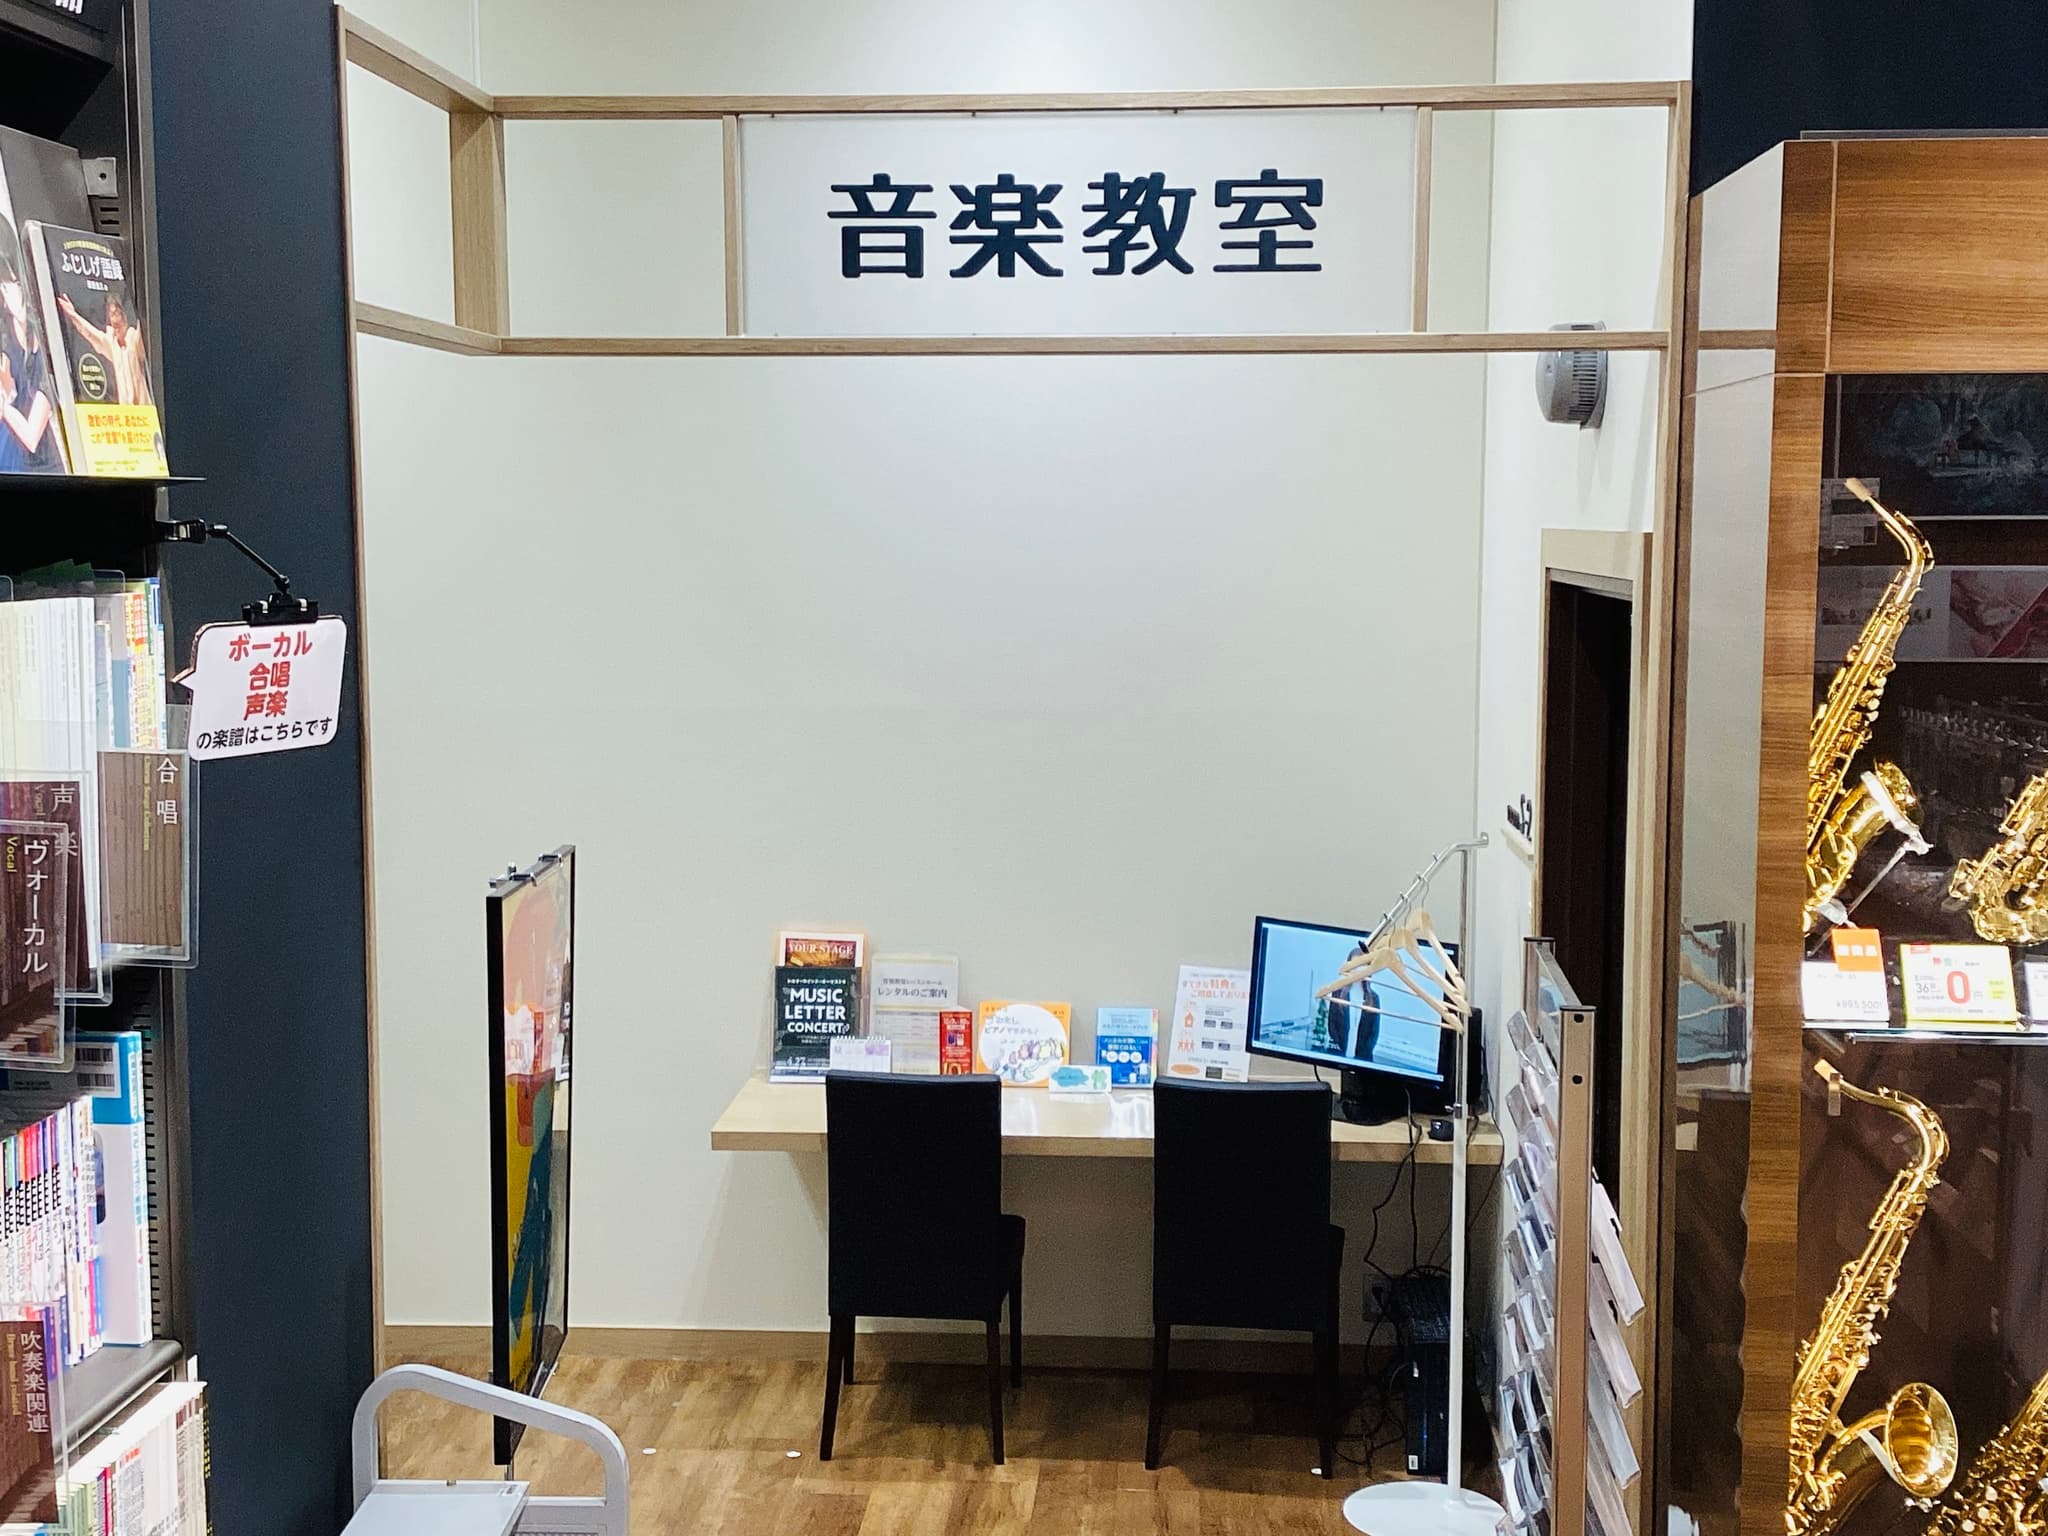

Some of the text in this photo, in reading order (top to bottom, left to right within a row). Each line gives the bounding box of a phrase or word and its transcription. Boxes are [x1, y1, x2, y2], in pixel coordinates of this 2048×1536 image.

[827, 168, 1324, 278] 音楽教室
[229, 630, 313, 662] ボーカル
[249, 661, 291, 691] 合唱
[243, 690, 289, 721] 声楽
[196, 716, 333, 750] の楽譜はこちらです
[156, 757, 179, 825] 合唱
[51, 784, 78, 857] 声楽
[6, 836, 18, 873] Vocal
[22, 839, 50, 974] ヴォーカル
[788, 943, 853, 955] YOUR STAGE
[790, 988, 843, 1003] MUSIC
[878, 987, 948, 999] レンタルのご案内
[785, 1005, 846, 1020] LETTER
[787, 1022, 843, 1034] CONCERT
[21, 1330, 49, 1433] 吹奏楽関連
